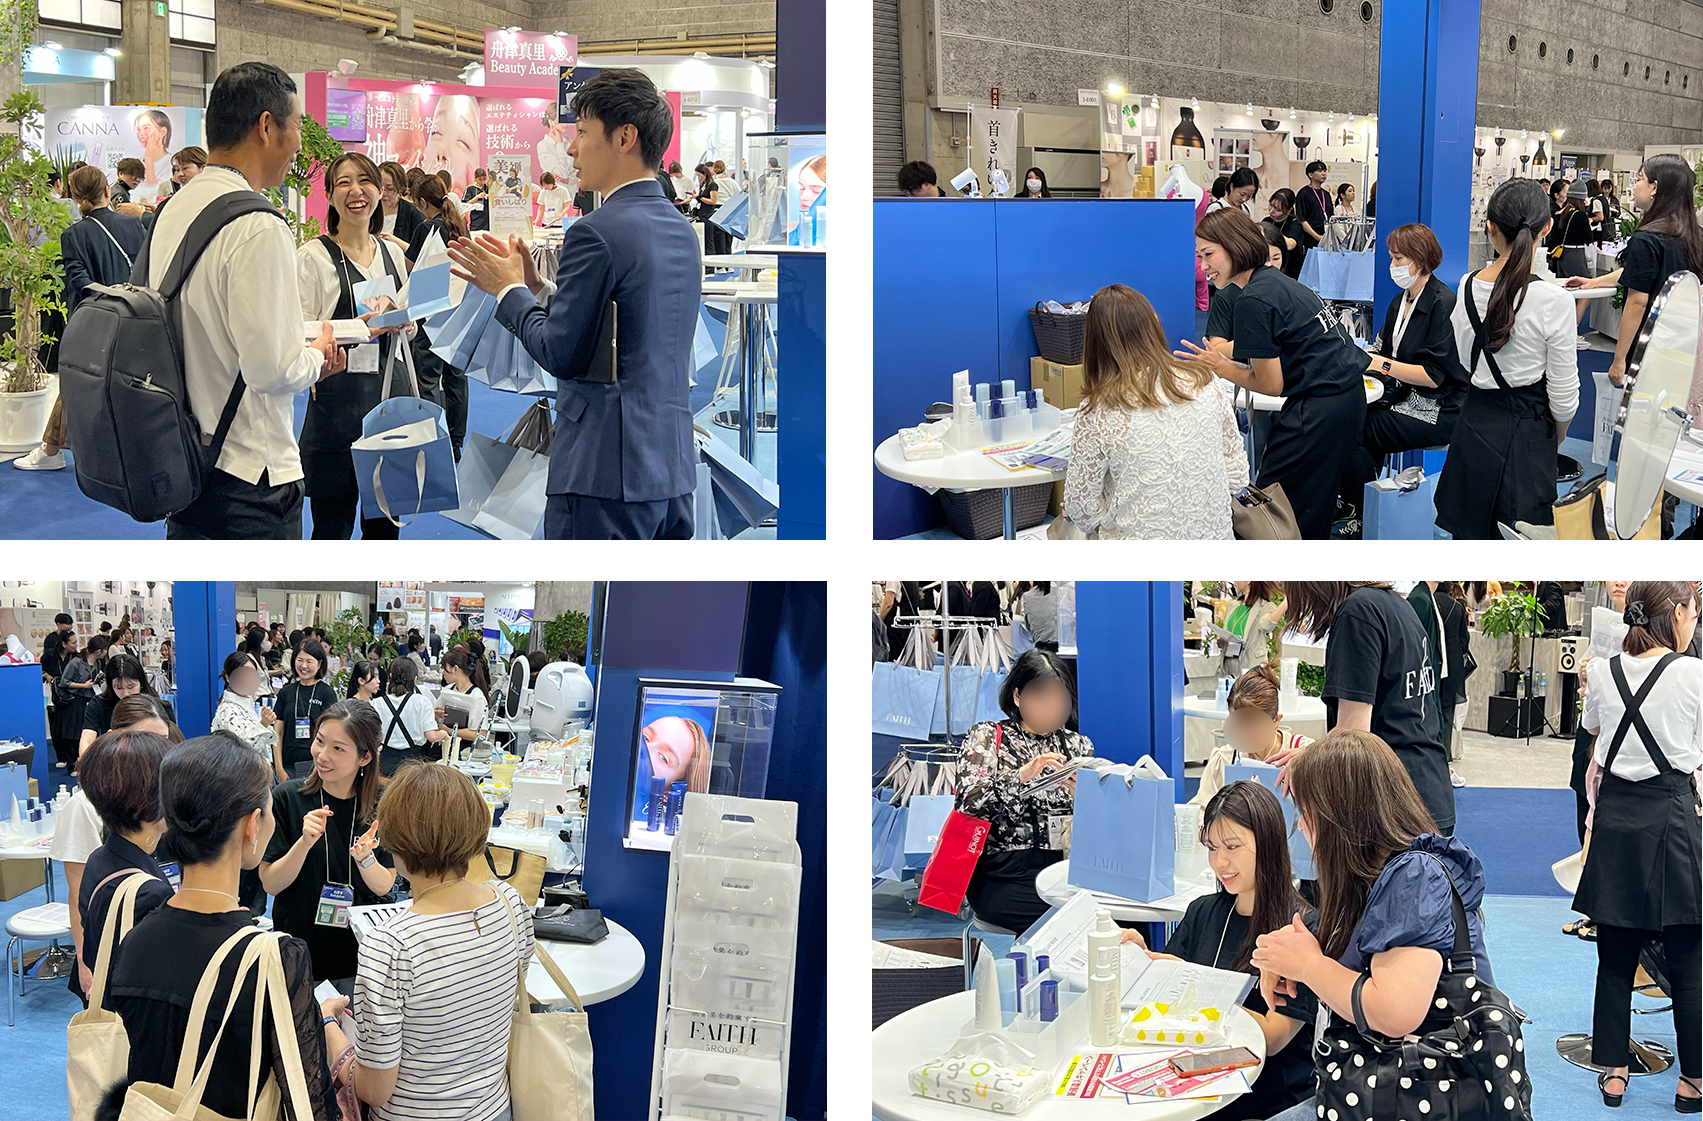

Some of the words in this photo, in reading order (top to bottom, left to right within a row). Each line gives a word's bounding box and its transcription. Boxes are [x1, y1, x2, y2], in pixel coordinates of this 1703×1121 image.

[490, 39, 546, 61] 舟津真里
[490, 60, 527, 76] Beauty
[529, 62, 559, 76] Acade
[57, 121, 120, 136] CANNA
[486, 124, 518, 133] 選ばれる
[486, 134, 531, 150] 技術から
[885, 714, 911, 725] FAITH
[966, 826, 985, 854] GUINOT
[1093, 855, 1124, 872] FAITH
[689, 1020, 757, 1046] FAITH
